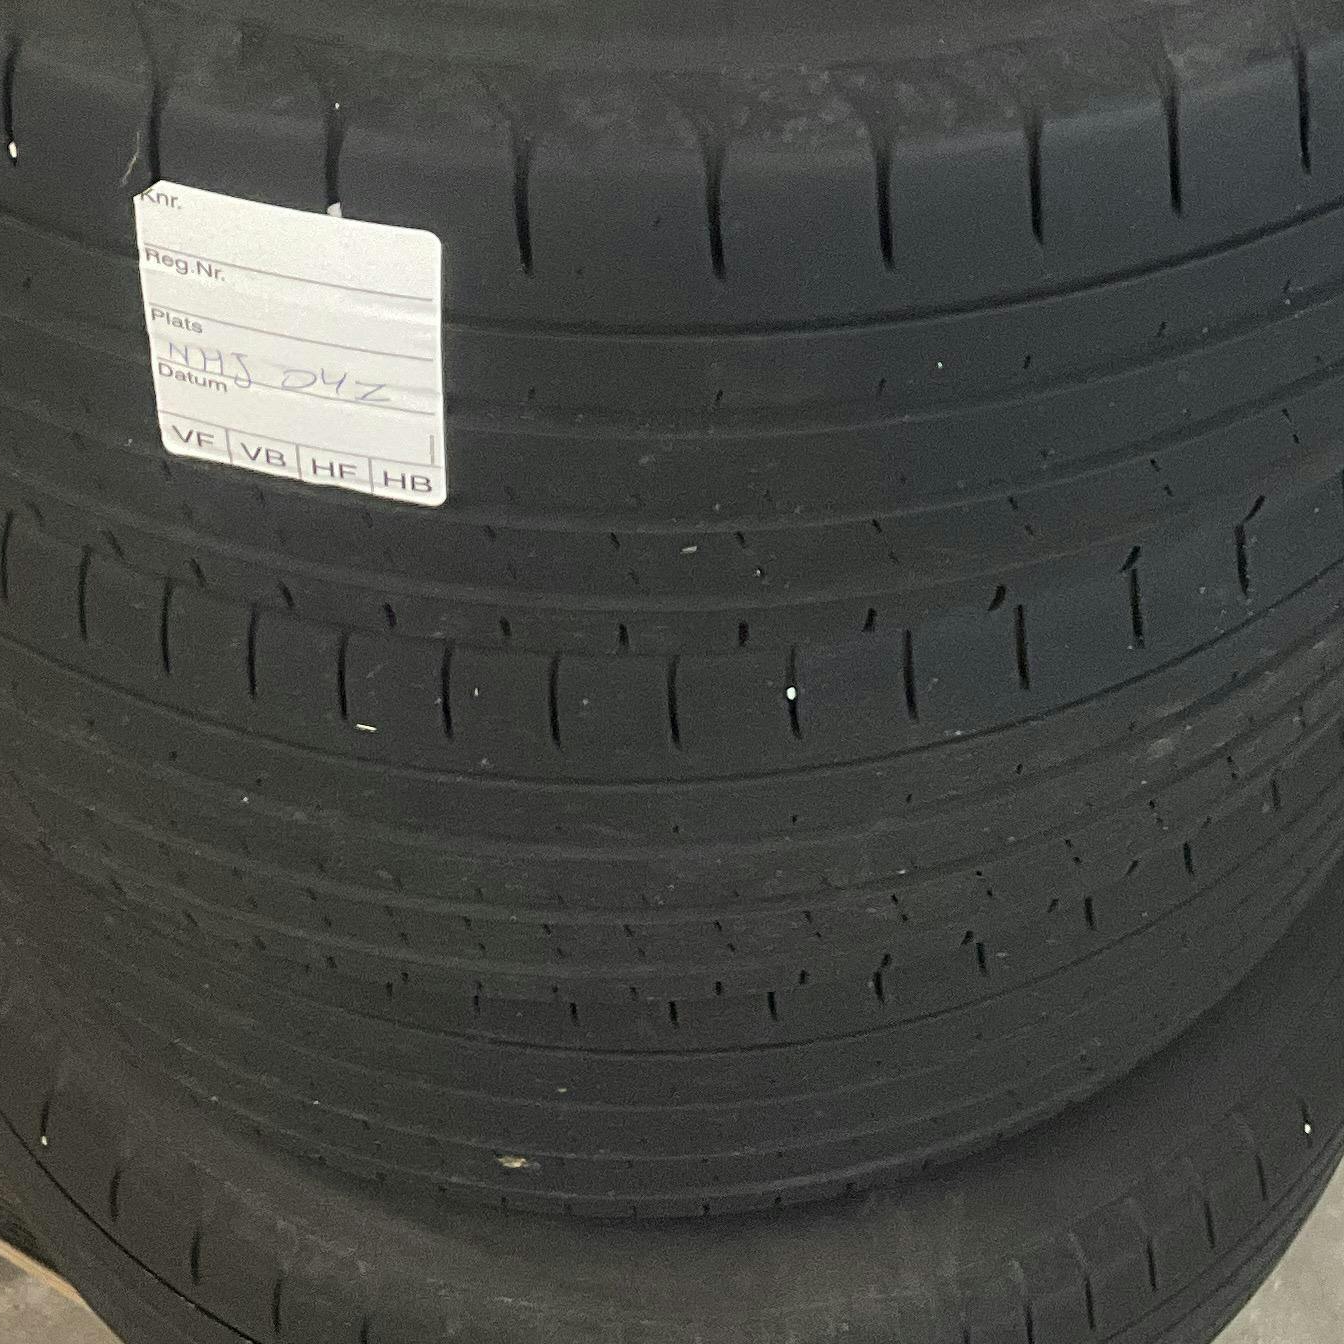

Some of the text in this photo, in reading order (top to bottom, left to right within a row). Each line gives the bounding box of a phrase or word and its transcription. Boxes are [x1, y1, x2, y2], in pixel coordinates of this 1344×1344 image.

[140, 188, 182, 210] Knr.
[145, 247, 226, 282] Reg.Nr.
[151, 307, 203, 334] Plats
[158, 362, 228, 393] Datum
[172, 425, 433, 494] VF VB HF HB
